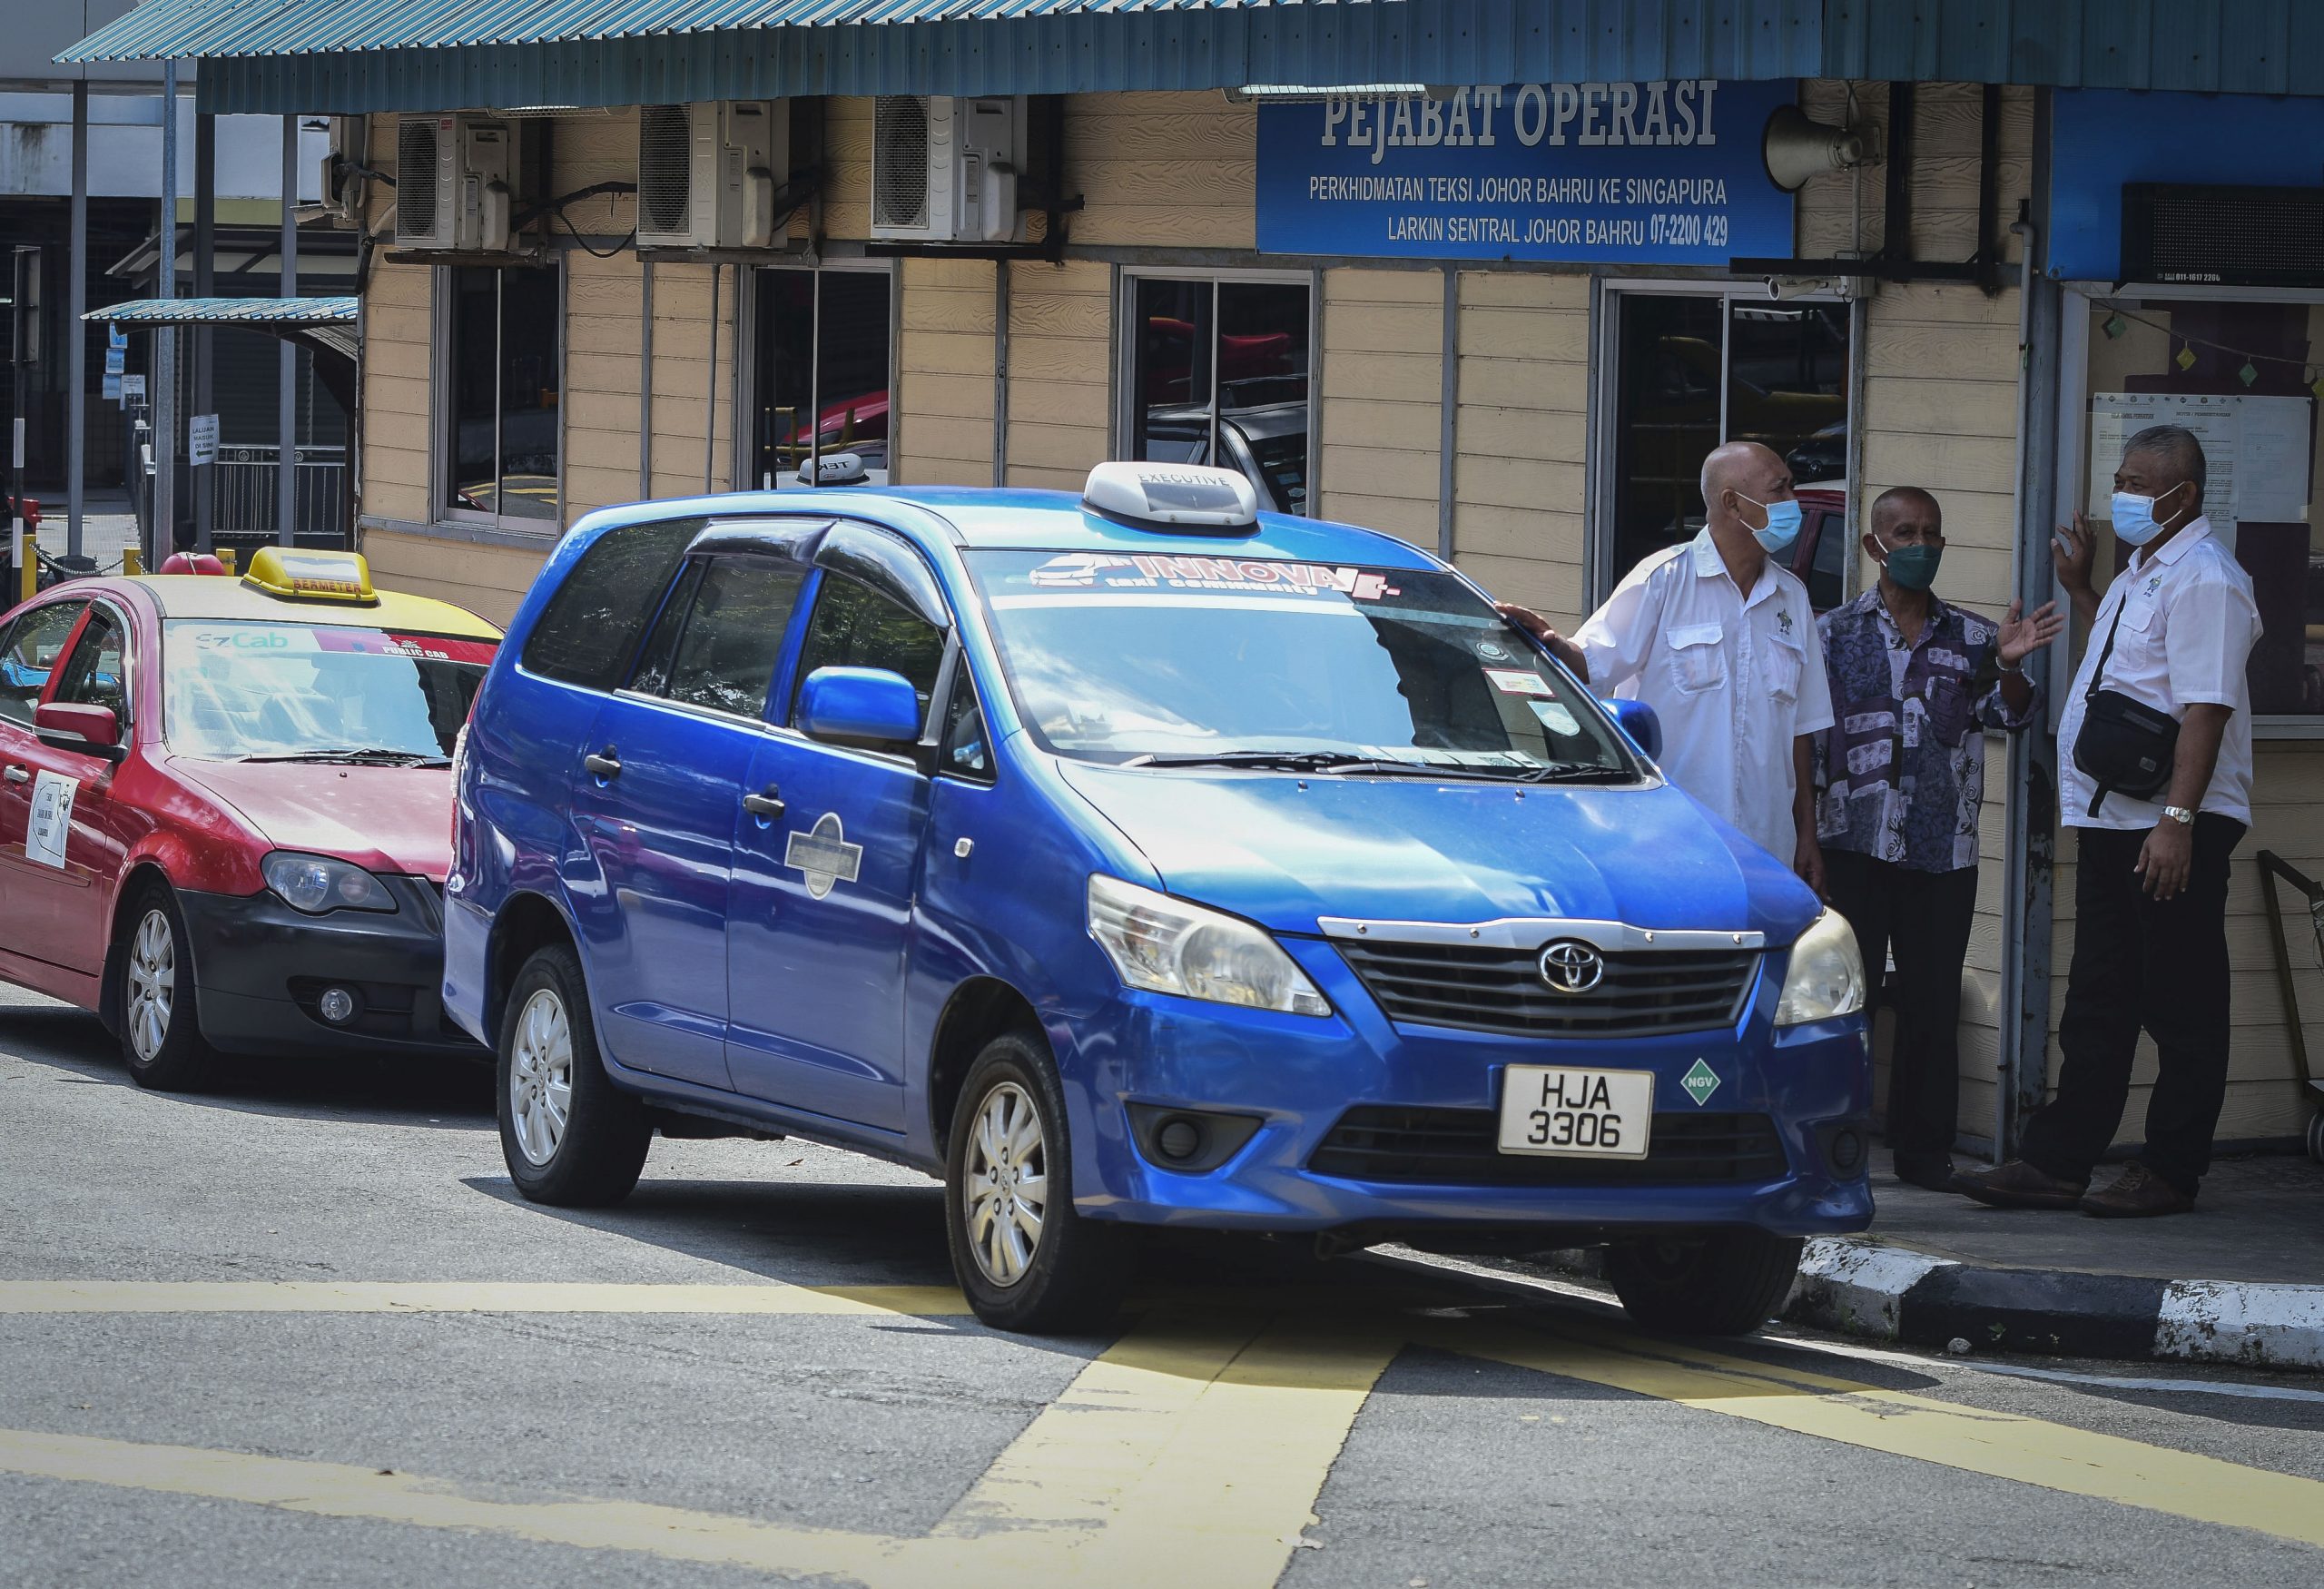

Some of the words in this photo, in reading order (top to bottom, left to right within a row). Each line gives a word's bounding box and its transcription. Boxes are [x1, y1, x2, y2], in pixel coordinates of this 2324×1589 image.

[1322, 85, 1502, 165] PEJABAT
[1514, 79, 1718, 147] OPERASI
[1310, 175, 1423, 202] PERKHIDMATAN
[1428, 177, 1472, 202] TEKSI
[1476, 177, 1531, 202] JOHOR
[1536, 178, 1594, 203] BAHRU
[1599, 178, 1620, 204] KE
[1625, 178, 1727, 205] SINGAPURA
[1388, 216, 1443, 242] LARKIN
[1448, 217, 1520, 243] SENTRAL
[1524, 218, 1581, 244] JOHOR
[1586, 220, 1644, 246] BAHRU
[1650, 213, 1700, 246] 07-2200
[1704, 215, 1728, 247] 429
[192, 426, 215, 434] LALUAN
[1137, 473, 1230, 487] EXECUTIVE
[1130, 556, 1348, 588] INNOVA
[293, 578, 361, 593] BERMETER
[1168, 578, 1318, 596] community
[382, 646, 424, 656] PUBLIC
[424, 650, 449, 659] CAB
[1541, 1073, 1611, 1110] HJA
[1687, 1077, 1714, 1088] NGV
[1527, 1110, 1621, 1148] 3306
